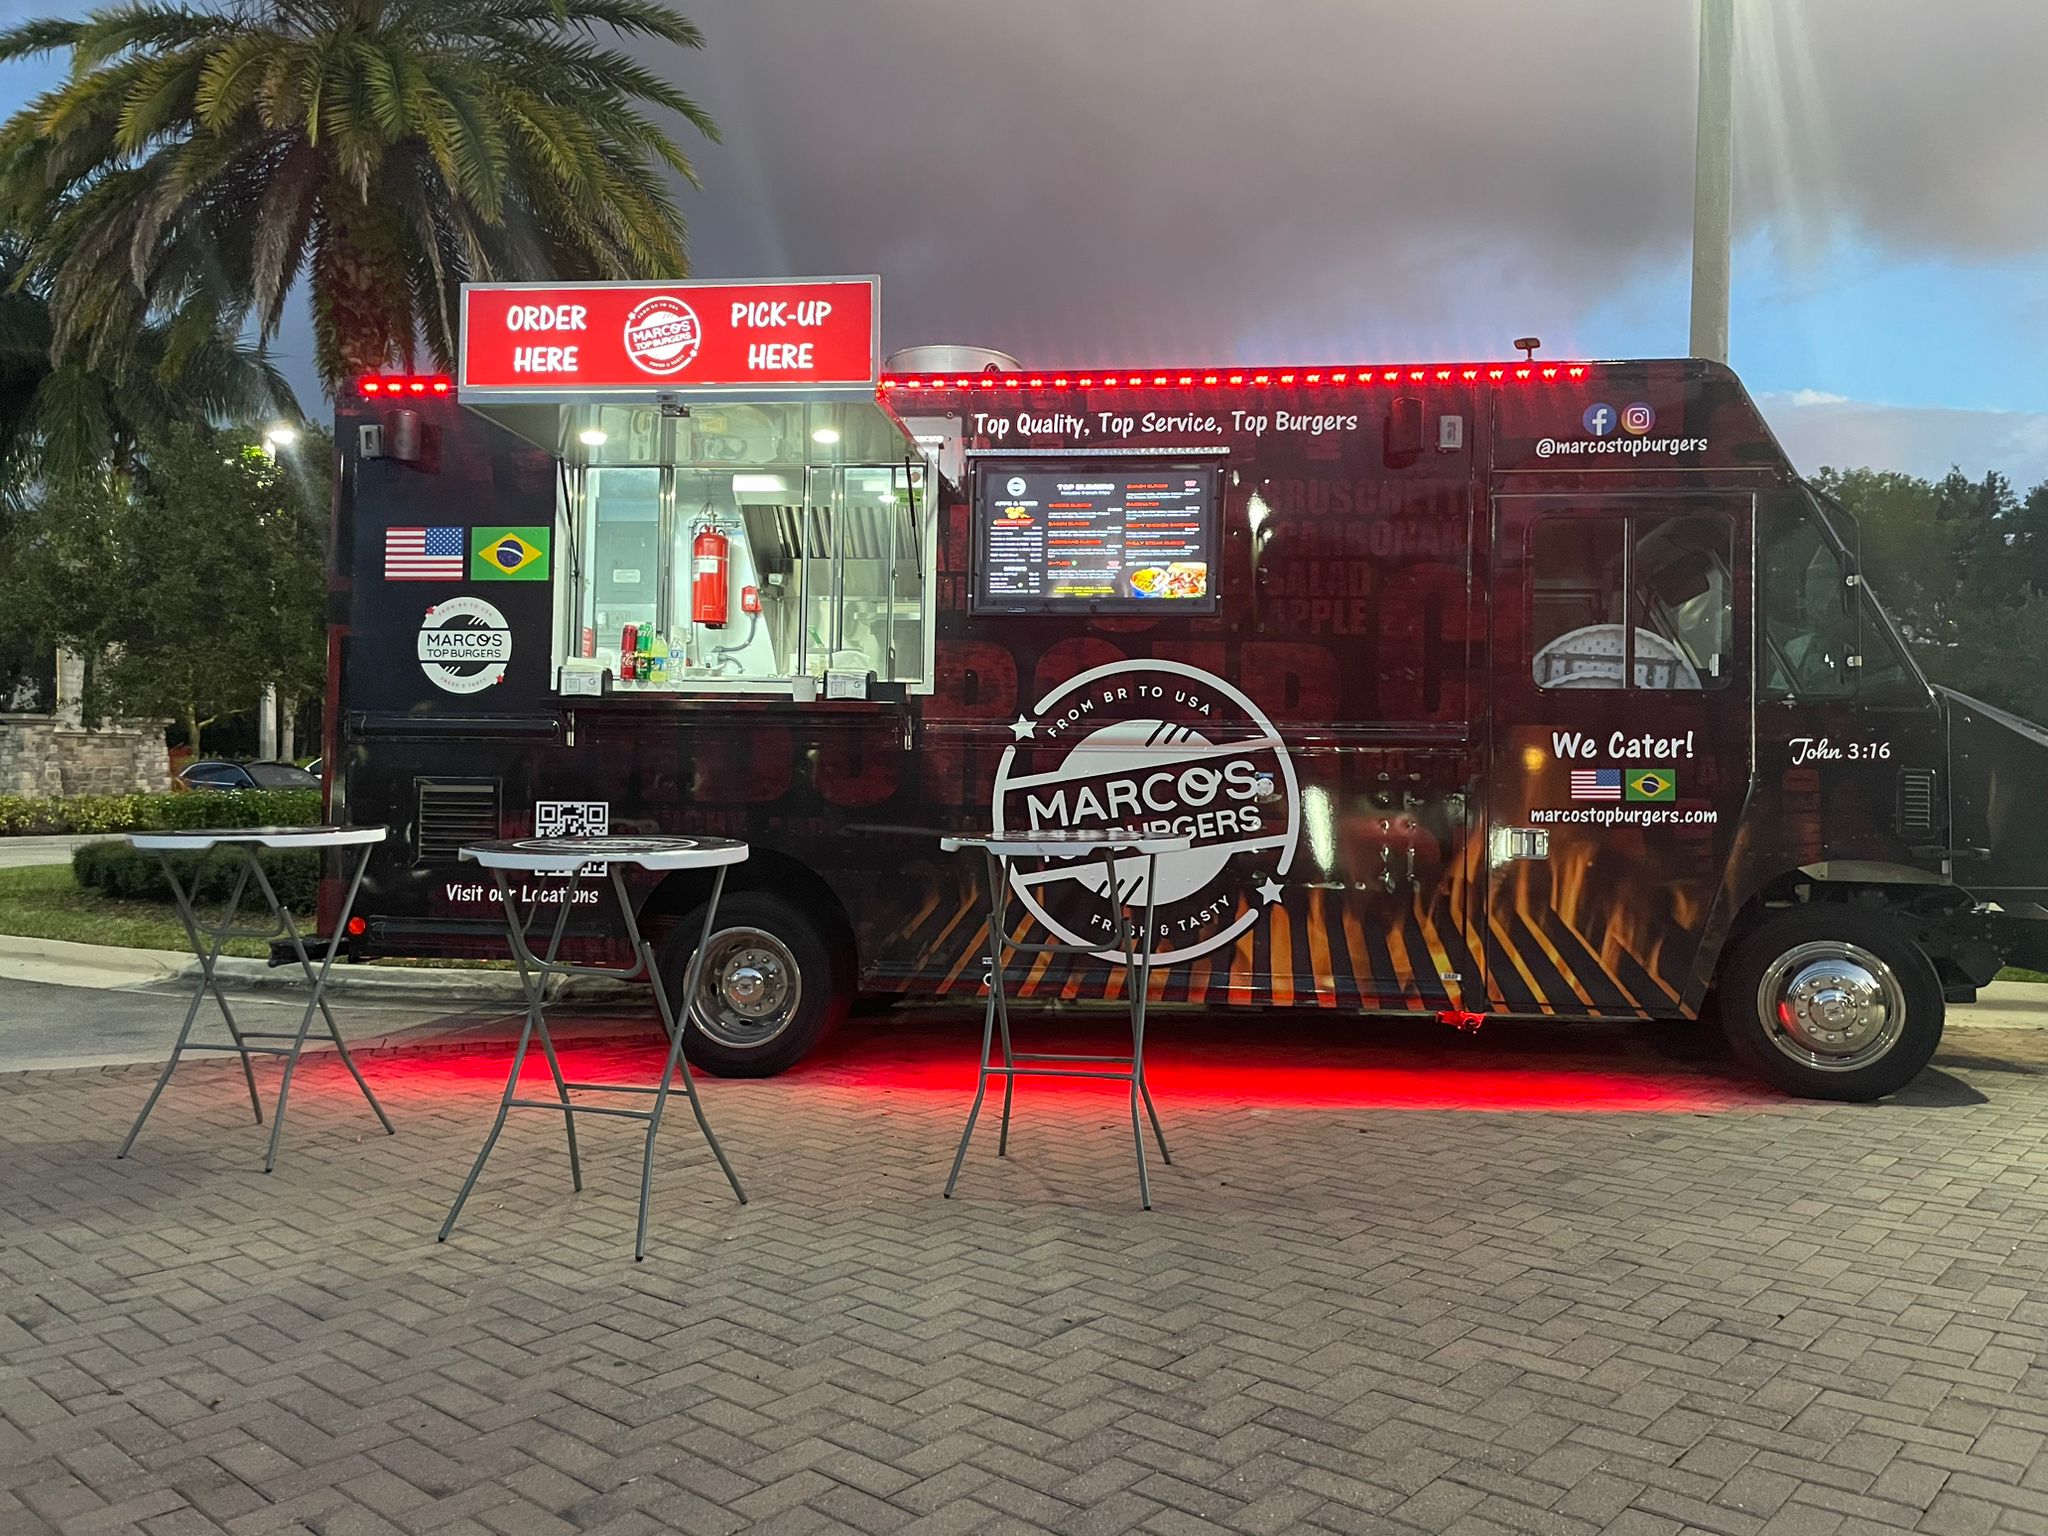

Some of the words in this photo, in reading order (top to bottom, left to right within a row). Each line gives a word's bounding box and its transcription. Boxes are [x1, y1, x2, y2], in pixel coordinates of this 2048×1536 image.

[507, 304, 587, 332] ORDER
[731, 301, 833, 328] PICK-UP
[513, 346, 580, 373] HERE
[747, 343, 815, 370] HERE
[975, 413, 1009, 439] Top
[1017, 411, 1090, 438] Quality,
[1099, 412, 1135, 438] Top
[1141, 411, 1223, 434] Service,
[1232, 411, 1266, 437] Top
[1275, 411, 1358, 435] Burgers
[1536, 436, 1708, 458] @marcostopburgers
[427, 649, 449, 658] TOP
[450, 649, 501, 658] BURGERS
[1047, 699, 1095, 738] FROM
[1103, 687, 1128, 703] BR
[1139, 685, 1163, 698] TO
[1175, 690, 1210, 716] USA
[1552, 731, 1598, 759] We
[1608, 731, 1695, 759] Cater!
[1788, 737, 1843, 767] John
[1847, 742, 1891, 760] 3:16
[1530, 806, 1718, 828] marcostopburgers.com
[446, 883, 483, 902] Visit
[1160, 924, 1169, 936] &
[1178, 894, 1230, 932] TASTY
